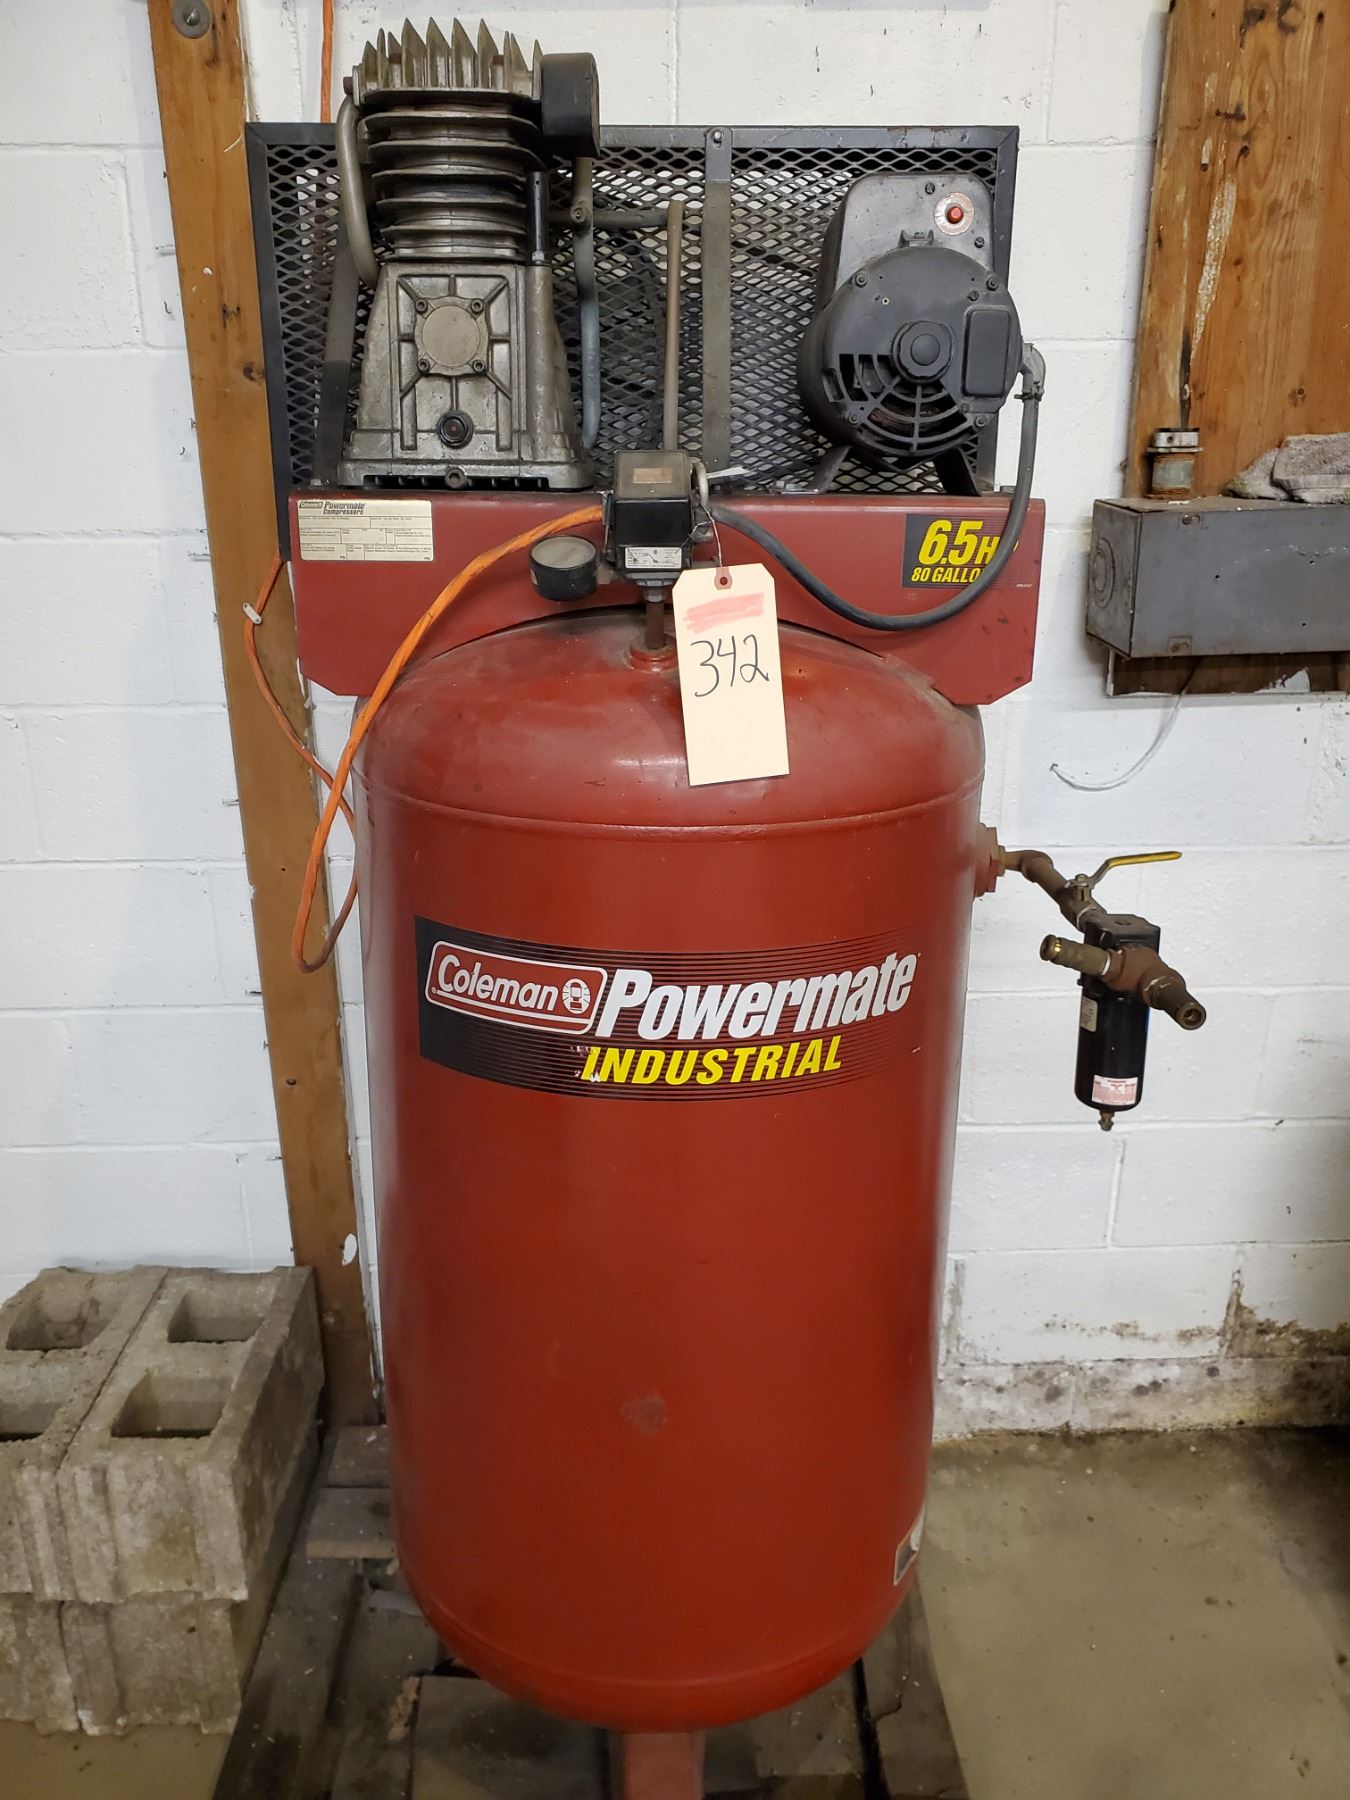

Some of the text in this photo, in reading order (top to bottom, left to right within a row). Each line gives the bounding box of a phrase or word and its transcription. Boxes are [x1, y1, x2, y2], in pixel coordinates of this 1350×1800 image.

[911, 567, 983, 583] 80 GALLO
[690, 634, 770, 697] 342
[437, 951, 918, 1040] Coleman Powermate
[581, 1034, 843, 1086] INDUSTRIAL
